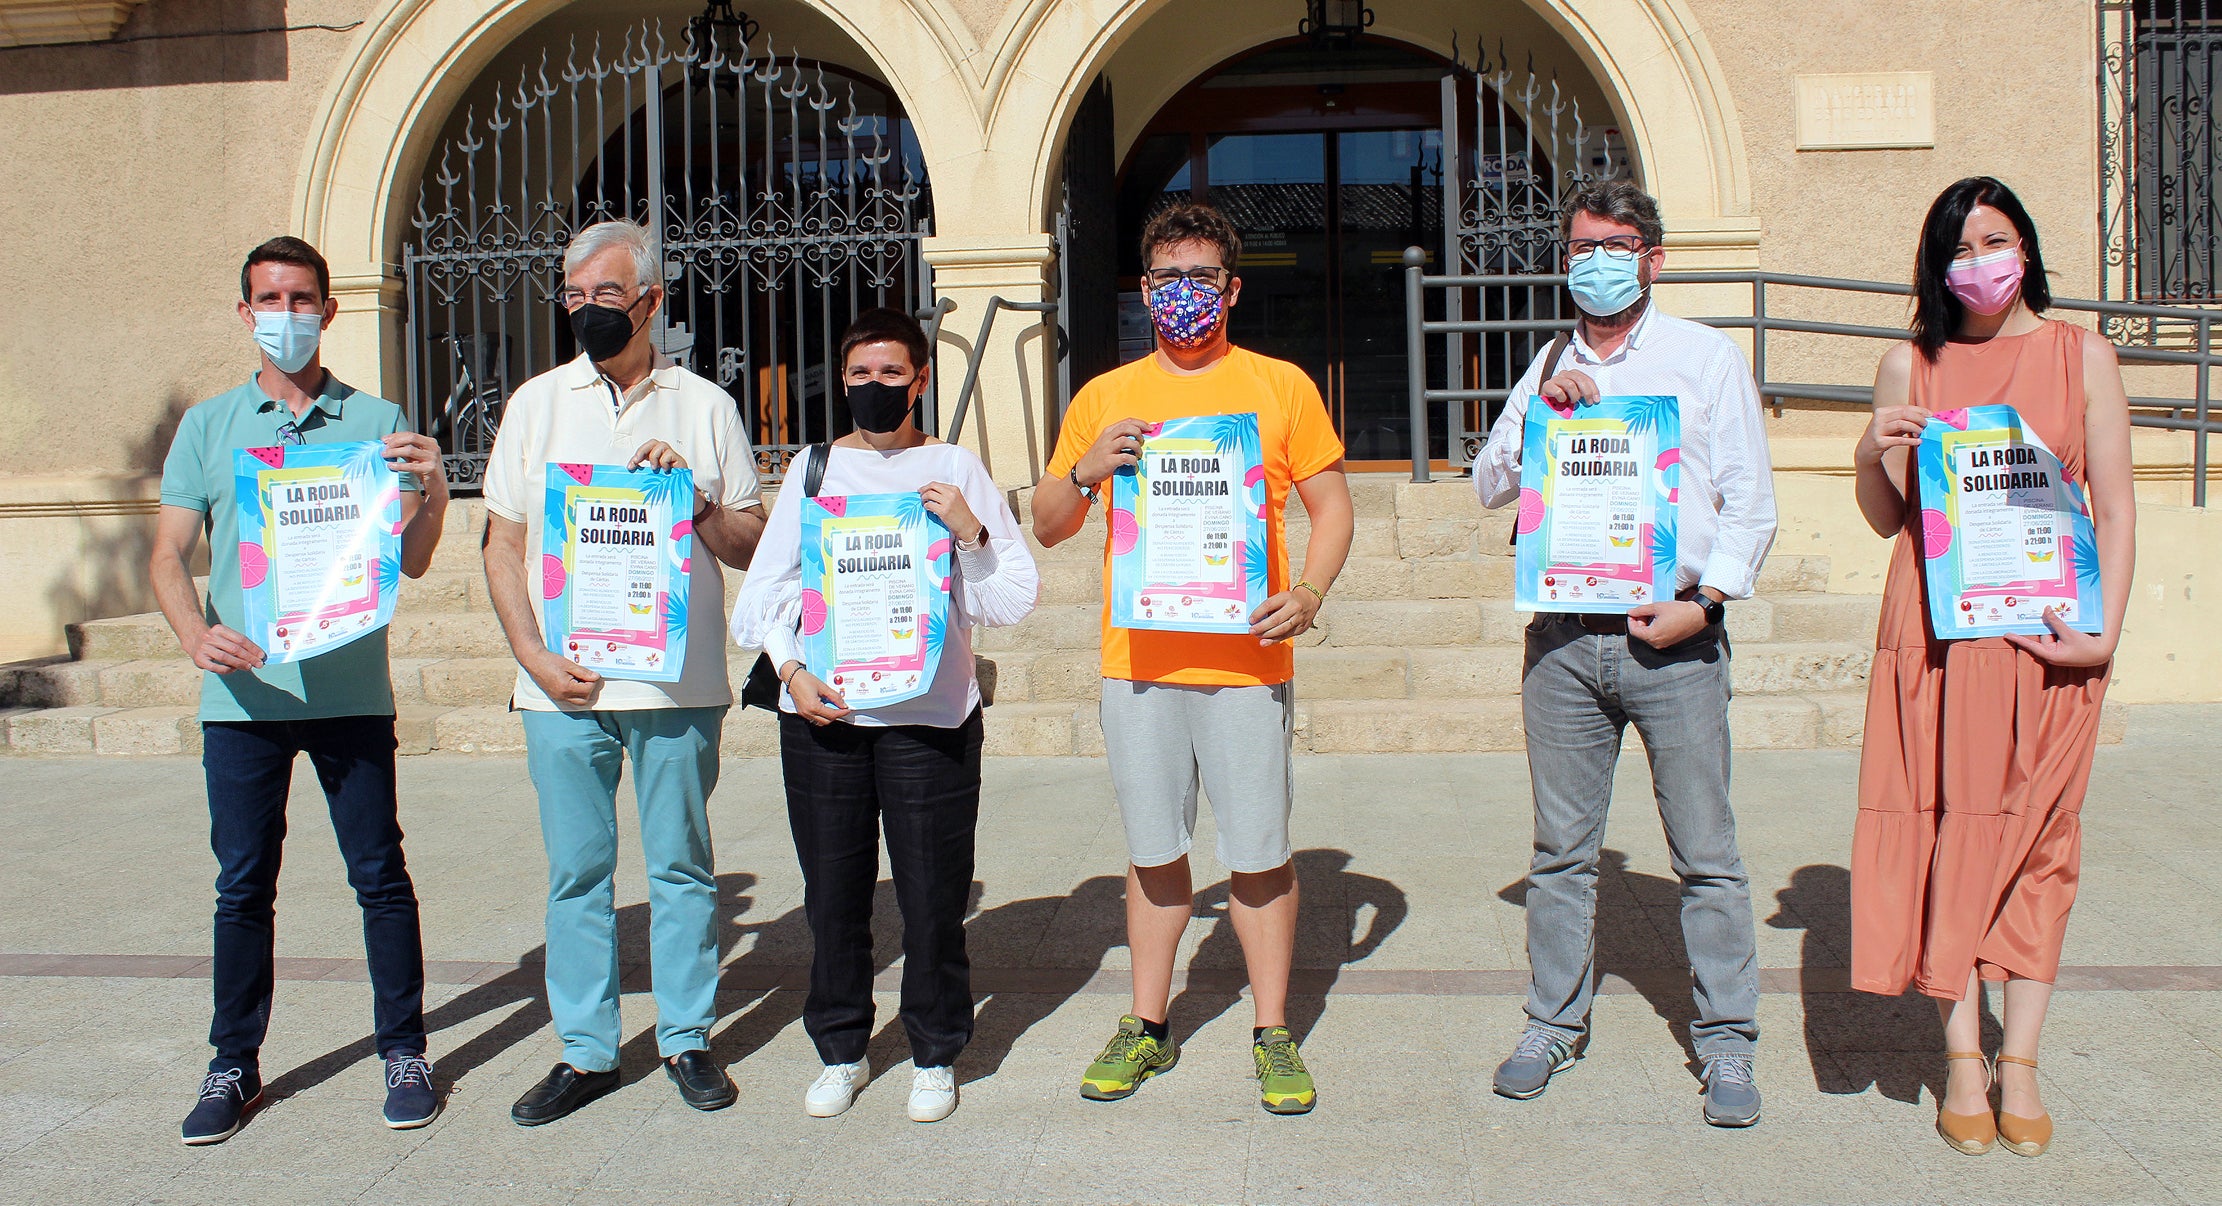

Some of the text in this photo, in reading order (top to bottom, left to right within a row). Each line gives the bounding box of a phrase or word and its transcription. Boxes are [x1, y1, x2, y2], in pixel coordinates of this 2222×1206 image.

[1483, 159, 1528, 172] RODA
[1571, 438, 1630, 454] LA RODA
[1161, 458, 1220, 473] LA RODA
[1971, 448, 2038, 468] LA RODA
[1561, 461, 1638, 477] SOLIDARIA
[1152, 480, 1229, 496] SOLIDARIA
[1963, 472, 2049, 492] SOLIDARIA
[287, 483, 350, 503] LA RODA
[279, 504, 360, 526] SOLIDARIA
[590, 506, 648, 523] LA RODA
[580, 528, 655, 546] SOLIDARIA
[846, 533, 903, 551] LA RODA
[838, 554, 911, 573] SOLIDARIA
